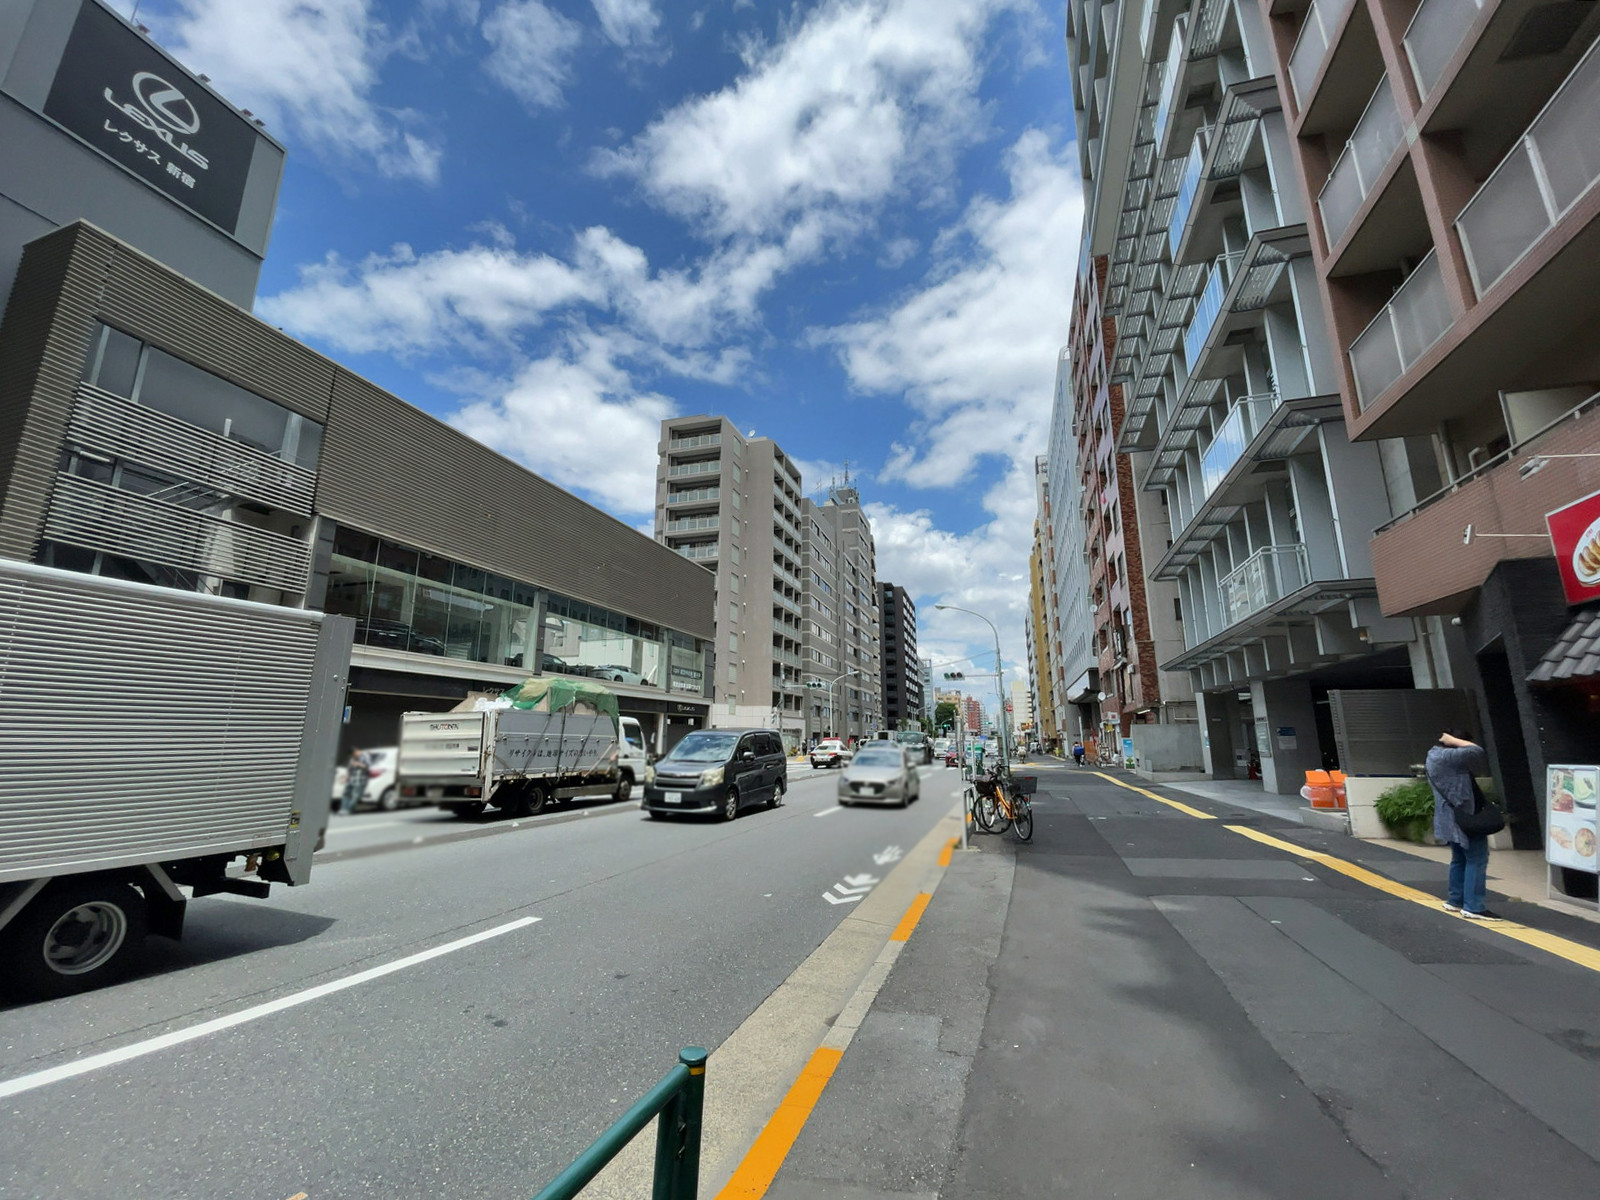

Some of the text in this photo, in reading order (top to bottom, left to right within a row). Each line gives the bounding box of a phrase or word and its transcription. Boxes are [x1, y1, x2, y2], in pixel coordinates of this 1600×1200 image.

[103, 86, 209, 170] LEXUS
[103, 119, 196, 188] レクサス 新宿
